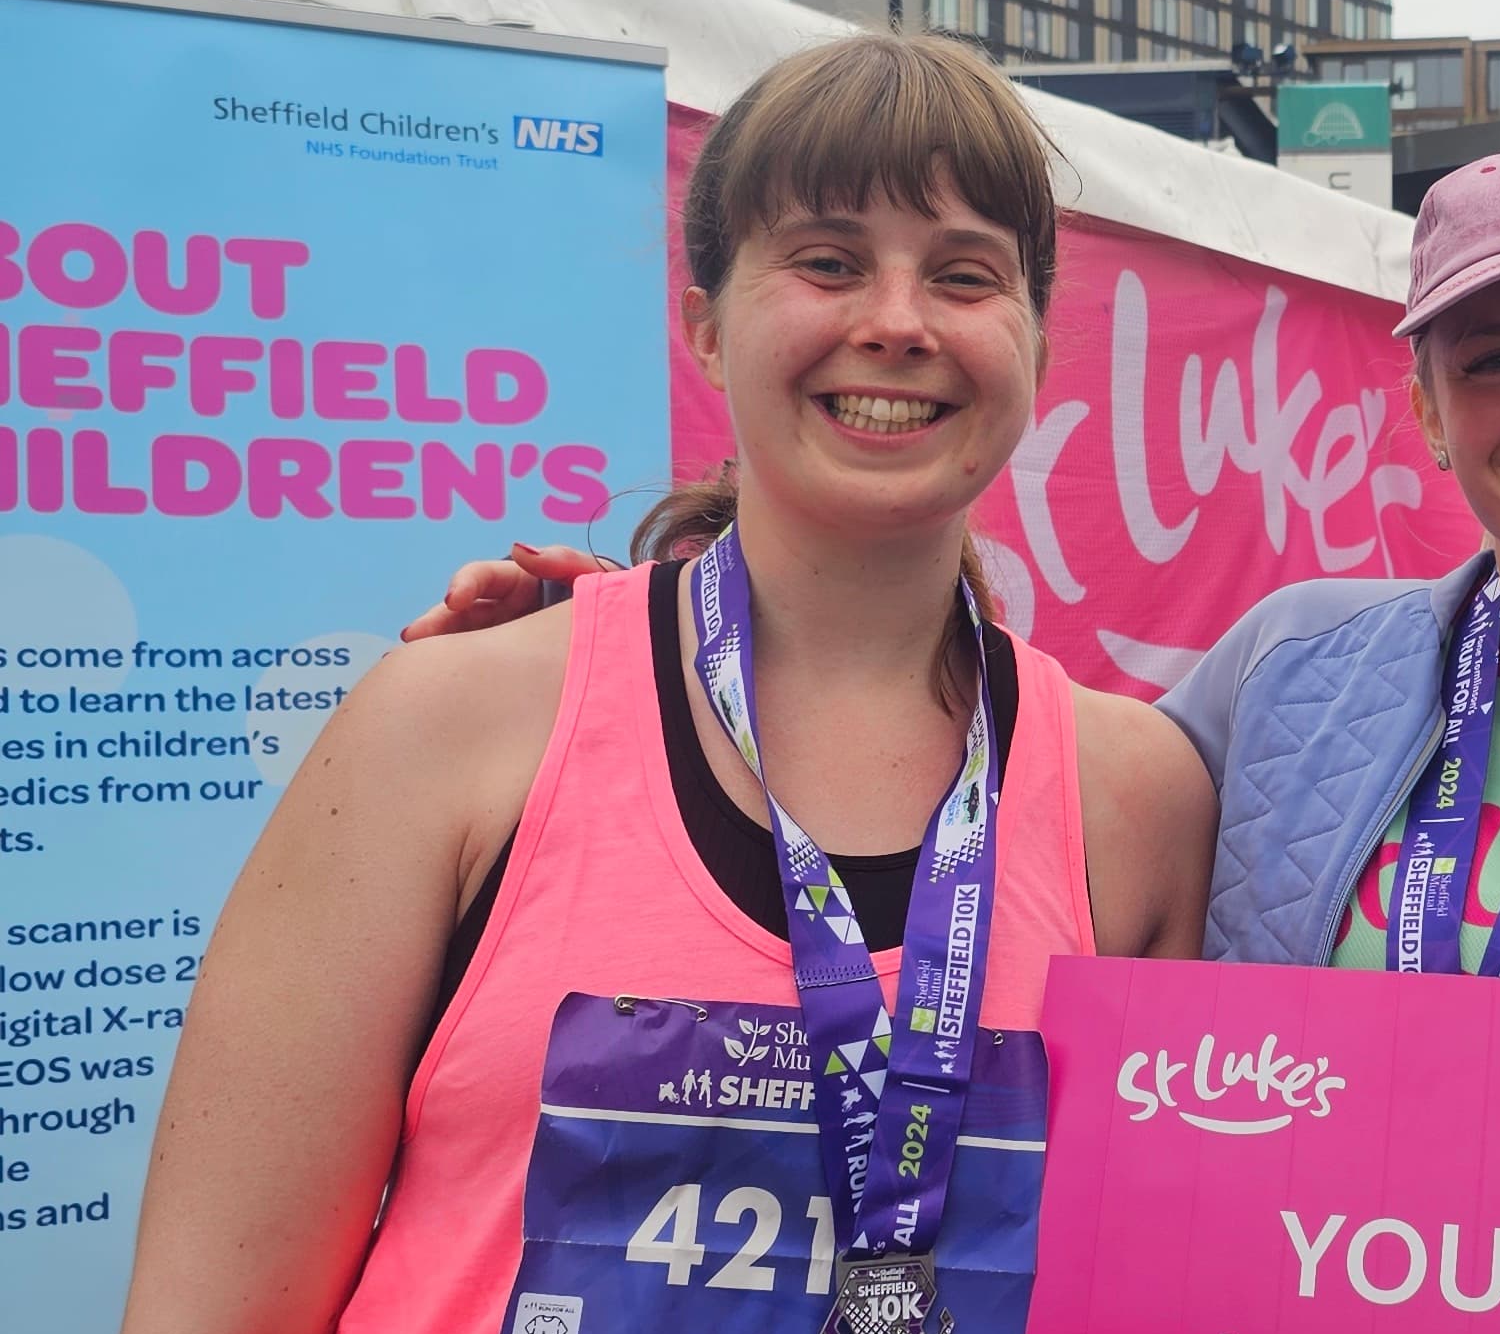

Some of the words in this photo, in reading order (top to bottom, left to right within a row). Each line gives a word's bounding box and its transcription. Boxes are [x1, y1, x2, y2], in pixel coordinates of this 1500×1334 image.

[213, 97, 348, 132] Sheffield
[360, 112, 499, 145] Children's
[515, 117, 601, 155] NHS
[306, 140, 344, 158] NHS
[350, 145, 451, 168] Foundation
[457, 154, 498, 170] Trust
[0, 322, 548, 425] EFFIELD
[0, 424, 610, 524] ILDREN'S
[16, 645, 124, 669] come
[134, 641, 223, 668] from
[231, 646, 351, 668] across
[1457, 638, 1475, 679] RUN
[20, 688, 60, 714] to
[69, 686, 165, 714] learn
[175, 686, 236, 713] the
[245, 685, 348, 712] latest
[1450, 678, 1471, 716] FOR
[55, 731, 88, 759] in
[97, 729, 280, 758] children's
[1442, 718, 1463, 749] ALL
[98, 776, 190, 804] from
[199, 779, 263, 801] our
[1435, 757, 1462, 811] 2024
[954, 886, 977, 923] 10K
[1401, 860, 1428, 955] SHEFFIELD
[7, 917, 164, 946] scanner
[172, 909, 201, 937] is
[74, 960, 166, 988] dose
[915, 959, 932, 1007] Sheffield
[940, 926, 972, 1035] SHEFFIELD
[103, 1005, 189, 1034] X-ra
[80, 1056, 154, 1080] was
[1116, 1049, 1188, 1122] St
[1193, 1033, 1346, 1118] Luke's
[898, 1104, 932, 1179] 2024
[36, 1192, 109, 1227] and
[893, 1199, 921, 1247] ALL
[857, 1280, 917, 1298] SHEFFIELD
[865, 1291, 924, 1323] 10K
